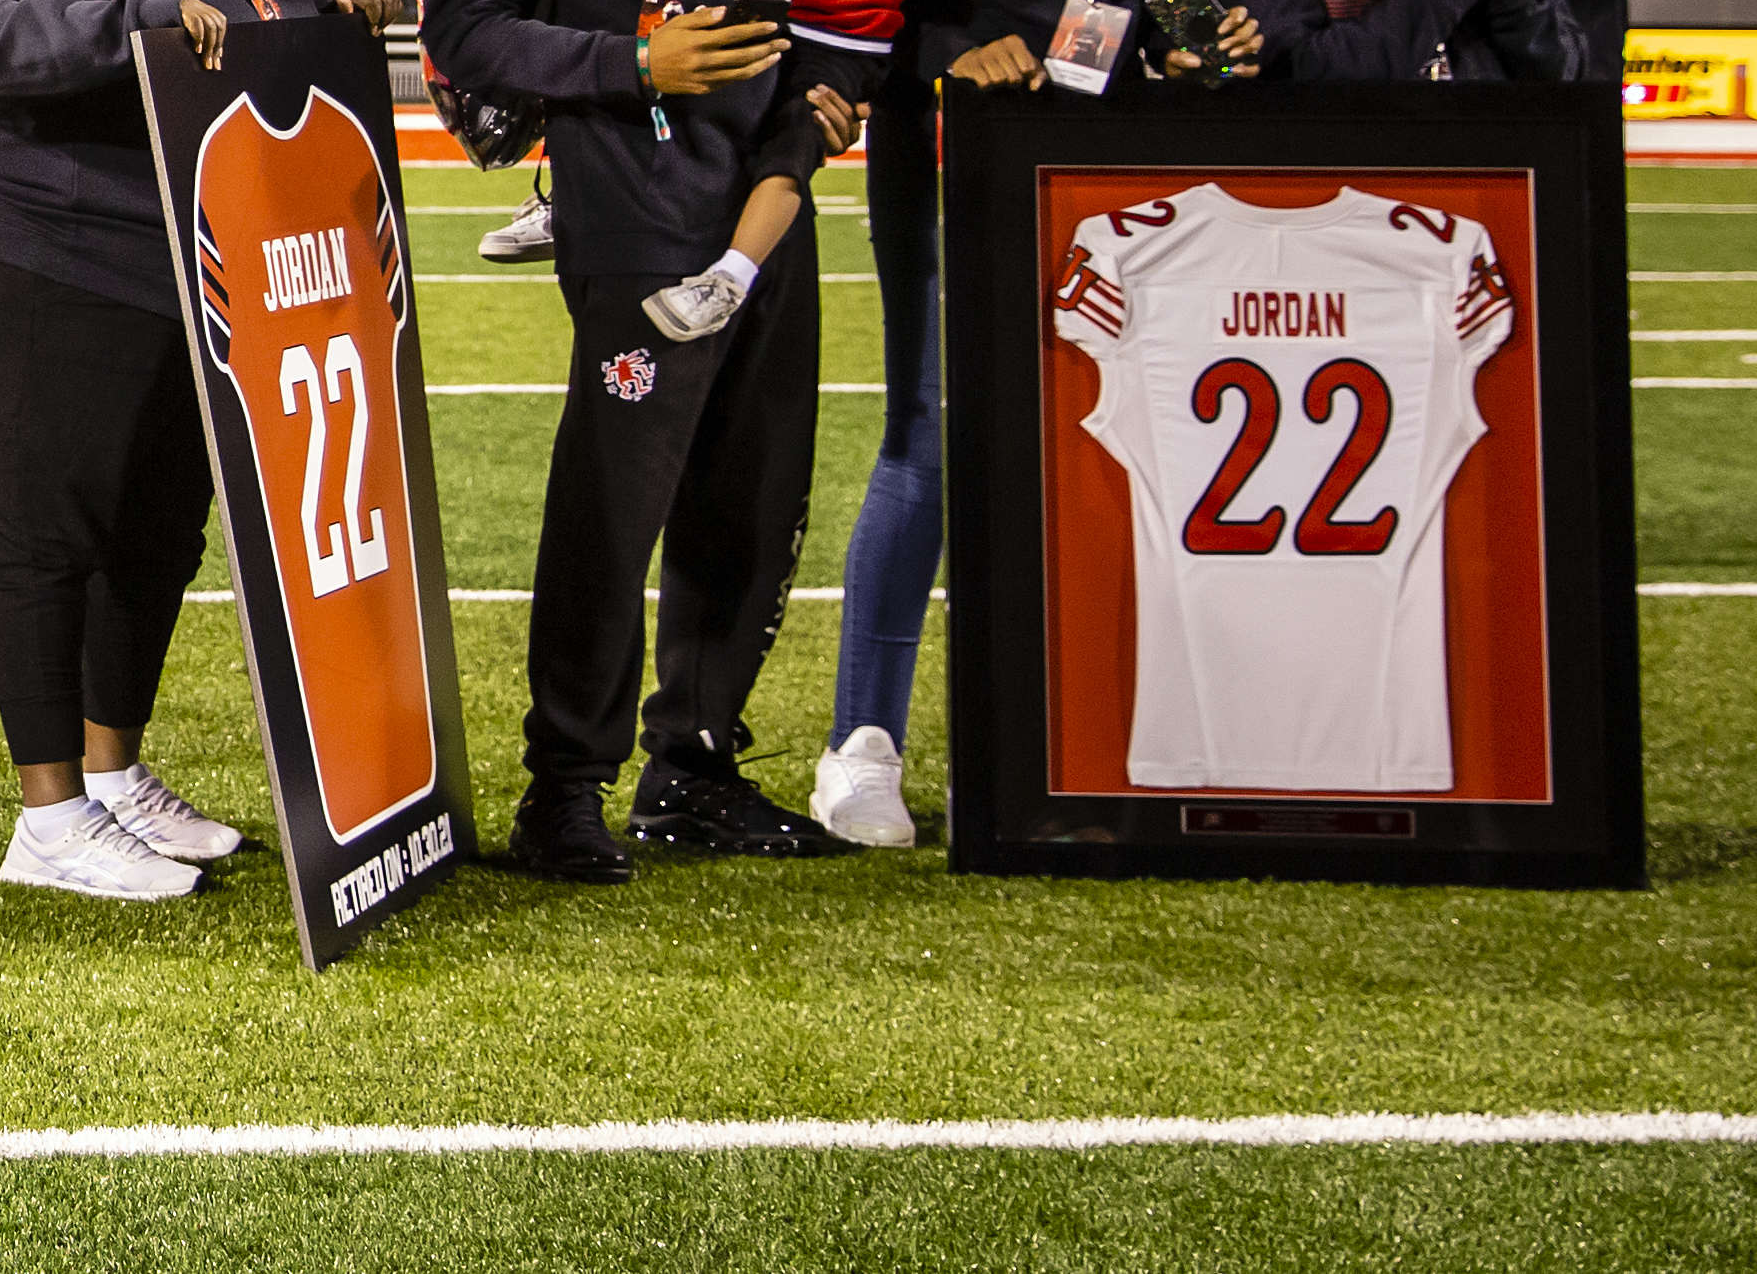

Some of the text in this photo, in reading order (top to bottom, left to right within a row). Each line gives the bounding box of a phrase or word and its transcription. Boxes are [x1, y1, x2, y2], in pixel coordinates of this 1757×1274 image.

[261, 226, 353, 313] JORDAN
[1221, 291, 1347, 338] JORDAN
[278, 332, 390, 600] 22
[1181, 356, 1399, 557] 22
[330, 855, 387, 928] RETIRED
[382, 842, 405, 893] ON
[407, 811, 455, 877] 10.30.21
